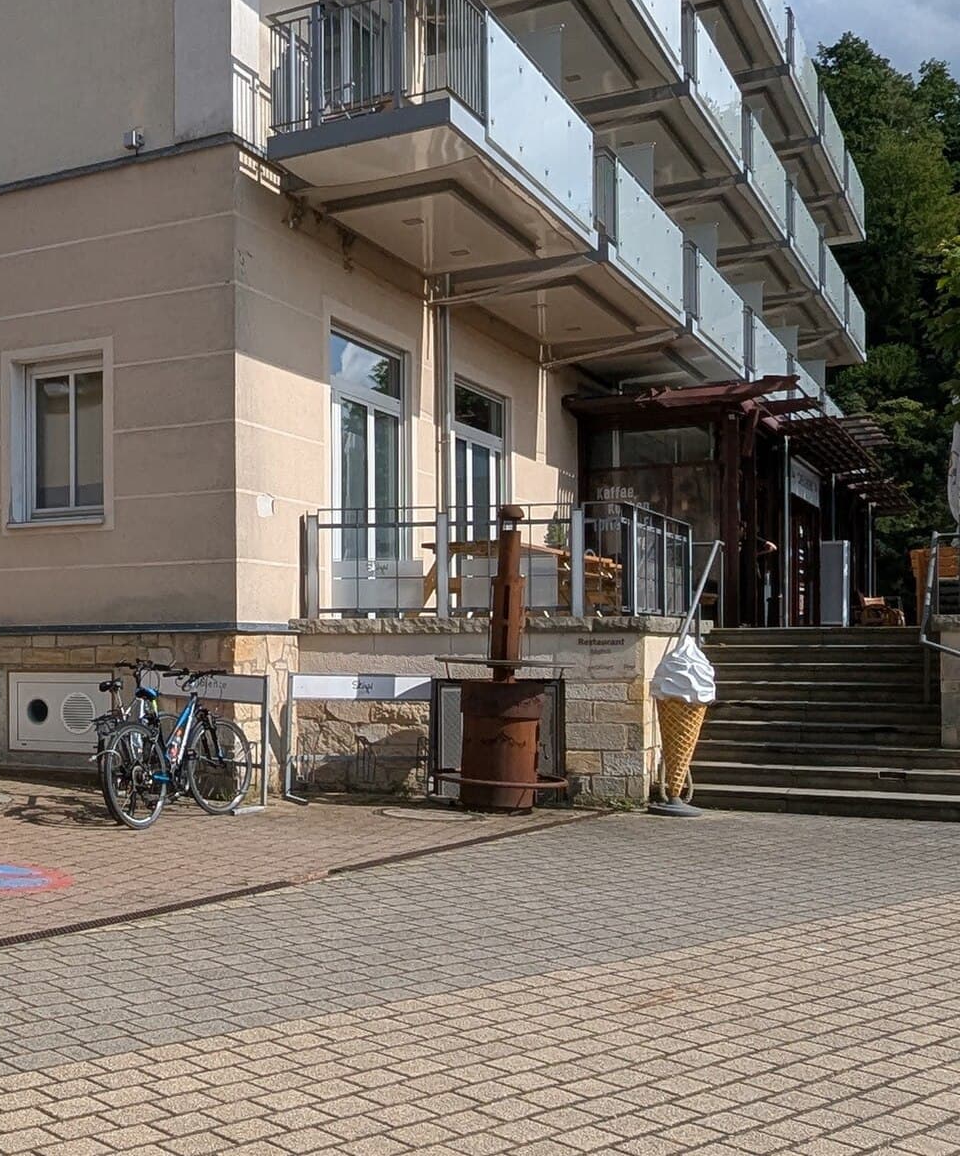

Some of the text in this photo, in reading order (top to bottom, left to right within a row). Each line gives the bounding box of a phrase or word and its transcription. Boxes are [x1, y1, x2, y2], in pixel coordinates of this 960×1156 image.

[596, 486, 637, 501] Kaffee,
[607, 502, 650, 516] Kuen
[577, 637, 625, 646] Restaurant
